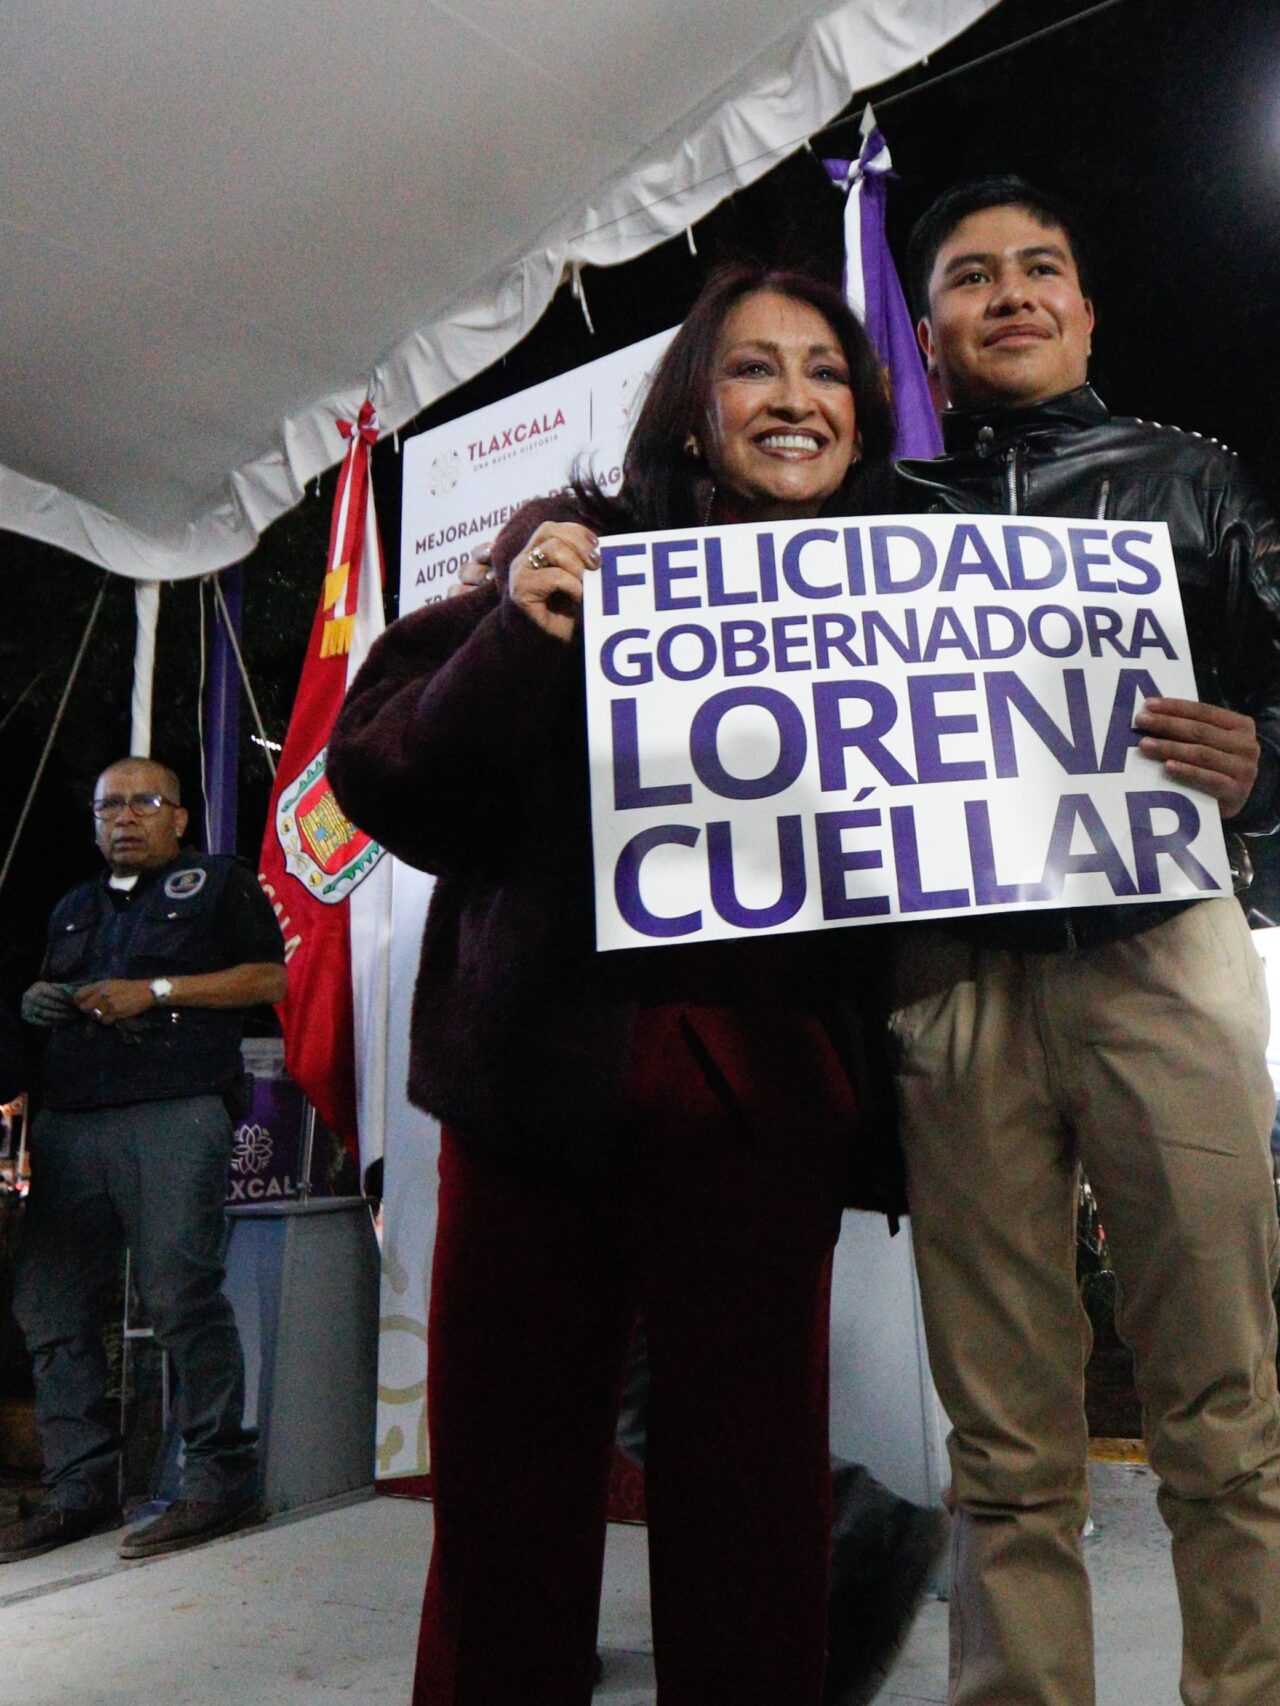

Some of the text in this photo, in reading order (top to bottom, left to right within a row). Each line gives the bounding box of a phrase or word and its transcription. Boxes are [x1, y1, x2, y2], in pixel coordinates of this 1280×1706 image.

[468, 408, 566, 462] TLAXCALA
[415, 502, 521, 555] MEJORAMIEN
[415, 552, 470, 588] AUTOP
[601, 523, 1161, 616] FELICIDADES
[599, 604, 1178, 686] GOBERNADORA
[610, 668, 1168, 812] LORENA
[613, 786, 1222, 938] CUÉLLAR
[228, 1175, 297, 1201] XCAL
